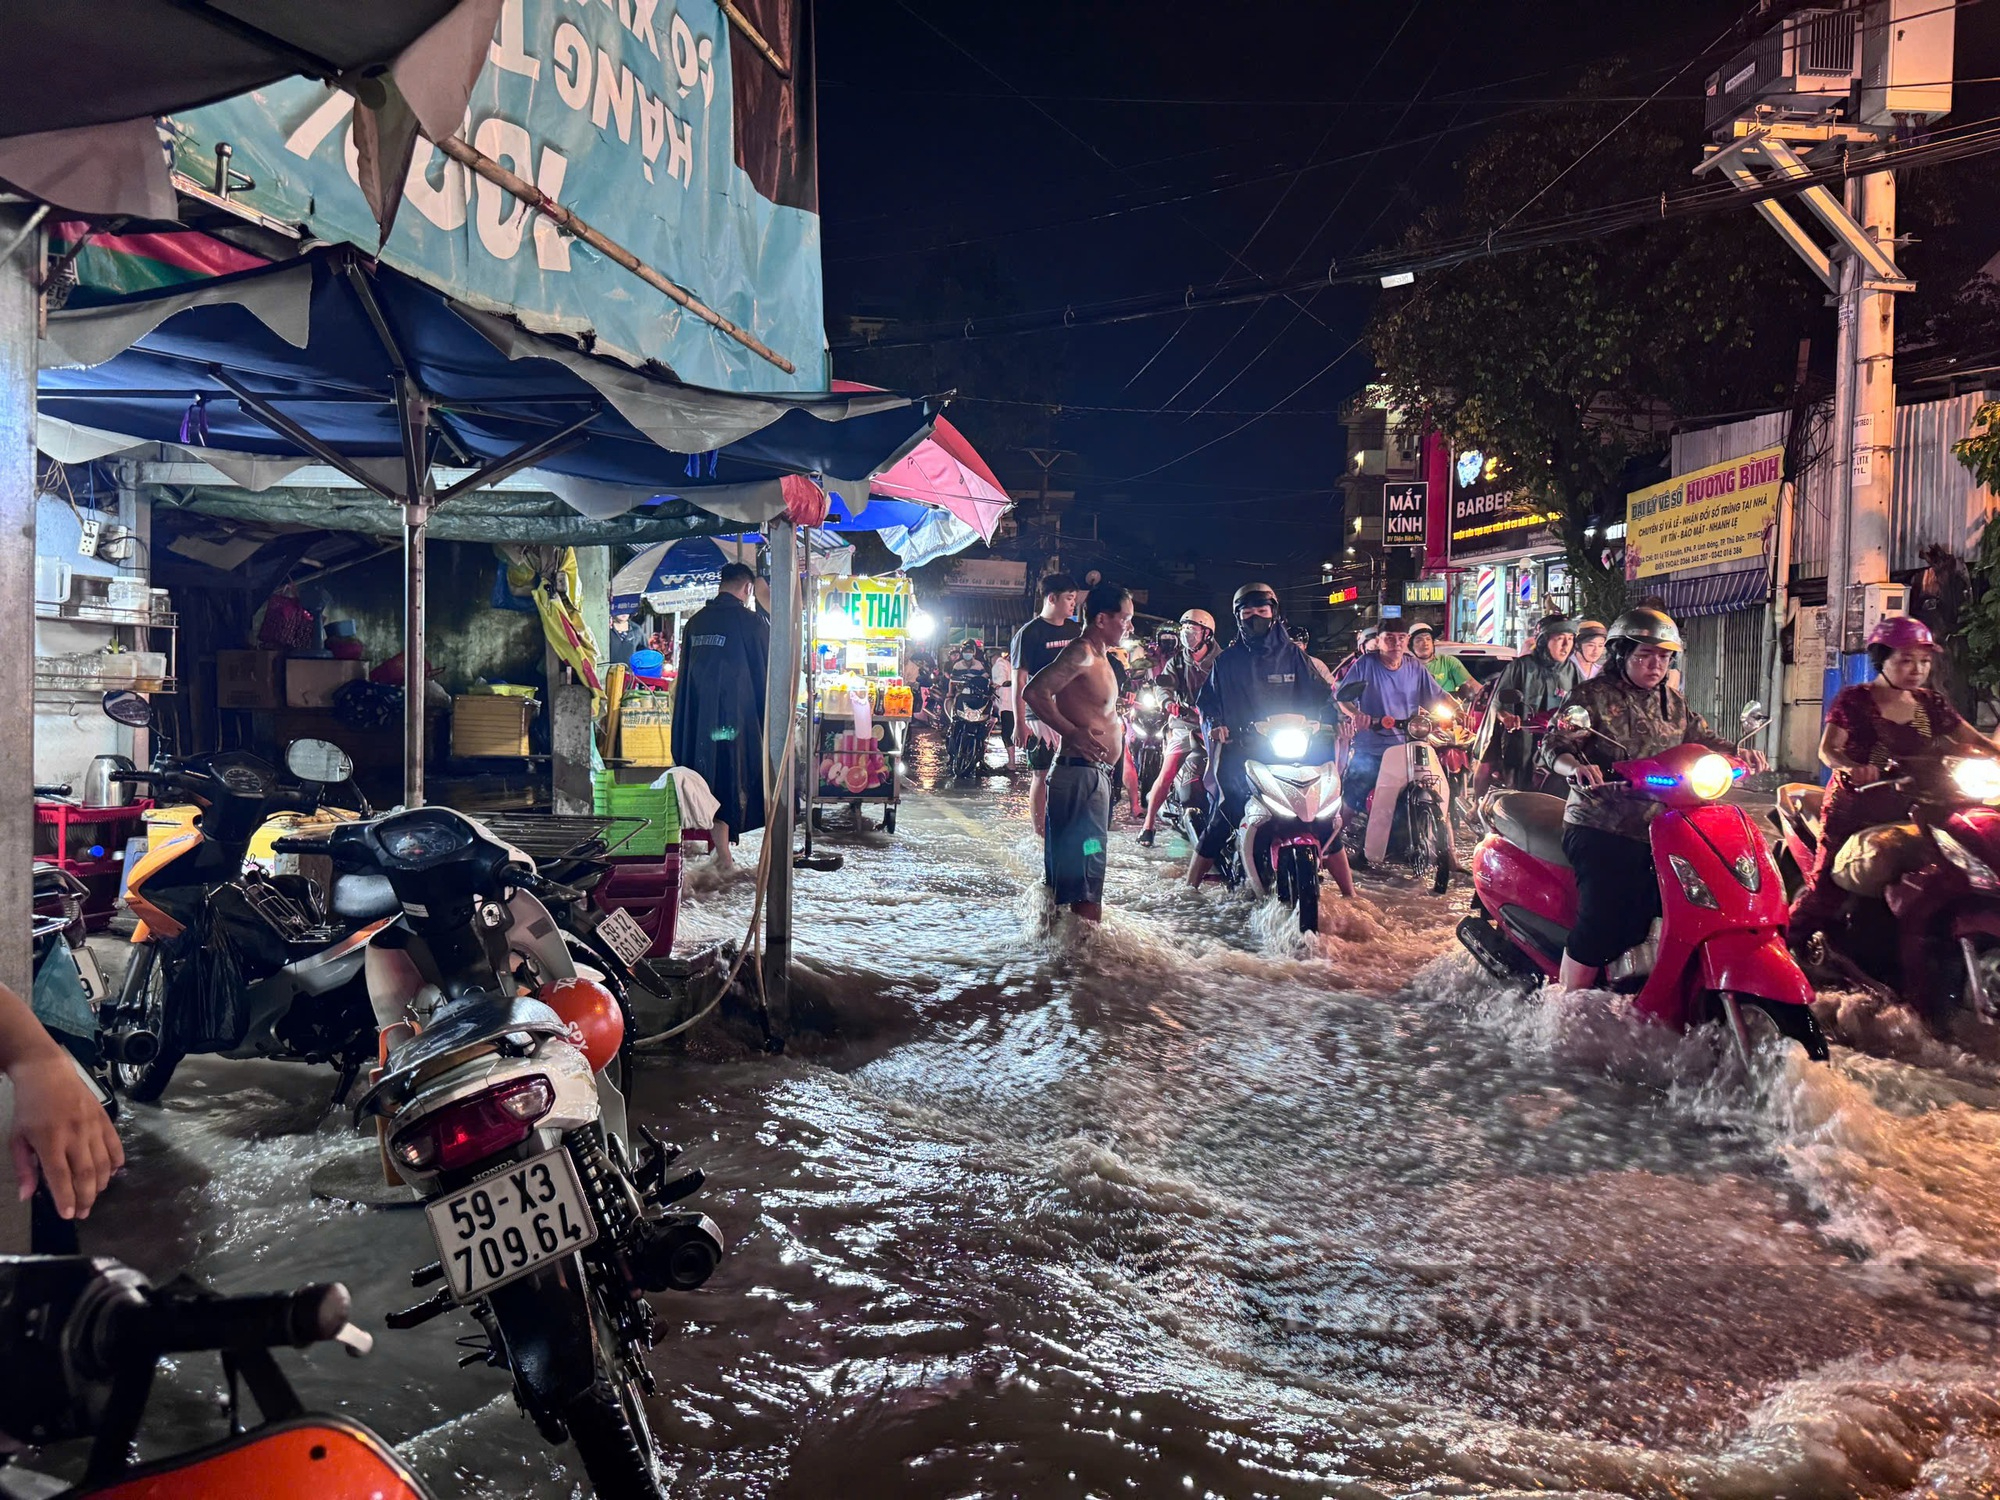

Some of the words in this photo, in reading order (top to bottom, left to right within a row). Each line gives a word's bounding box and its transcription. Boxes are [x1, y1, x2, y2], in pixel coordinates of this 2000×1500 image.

[1739, 456, 1780, 491] BÌNH
[1390, 488, 1422, 511] MẮT
[1711, 503, 1721, 518] SỐ
[1742, 500, 1752, 512] TẠI
[1388, 513, 1422, 533] KÍNH
[1709, 517, 1731, 532] NHANH
[866, 585, 910, 628] THÁI
[601, 913, 631, 942] 59-X2
[615, 929, 648, 963] 361.84
[472, 1160, 516, 1181] HONDA
[449, 1163, 556, 1240] 59-X3
[453, 1202, 582, 1292] 709.64
